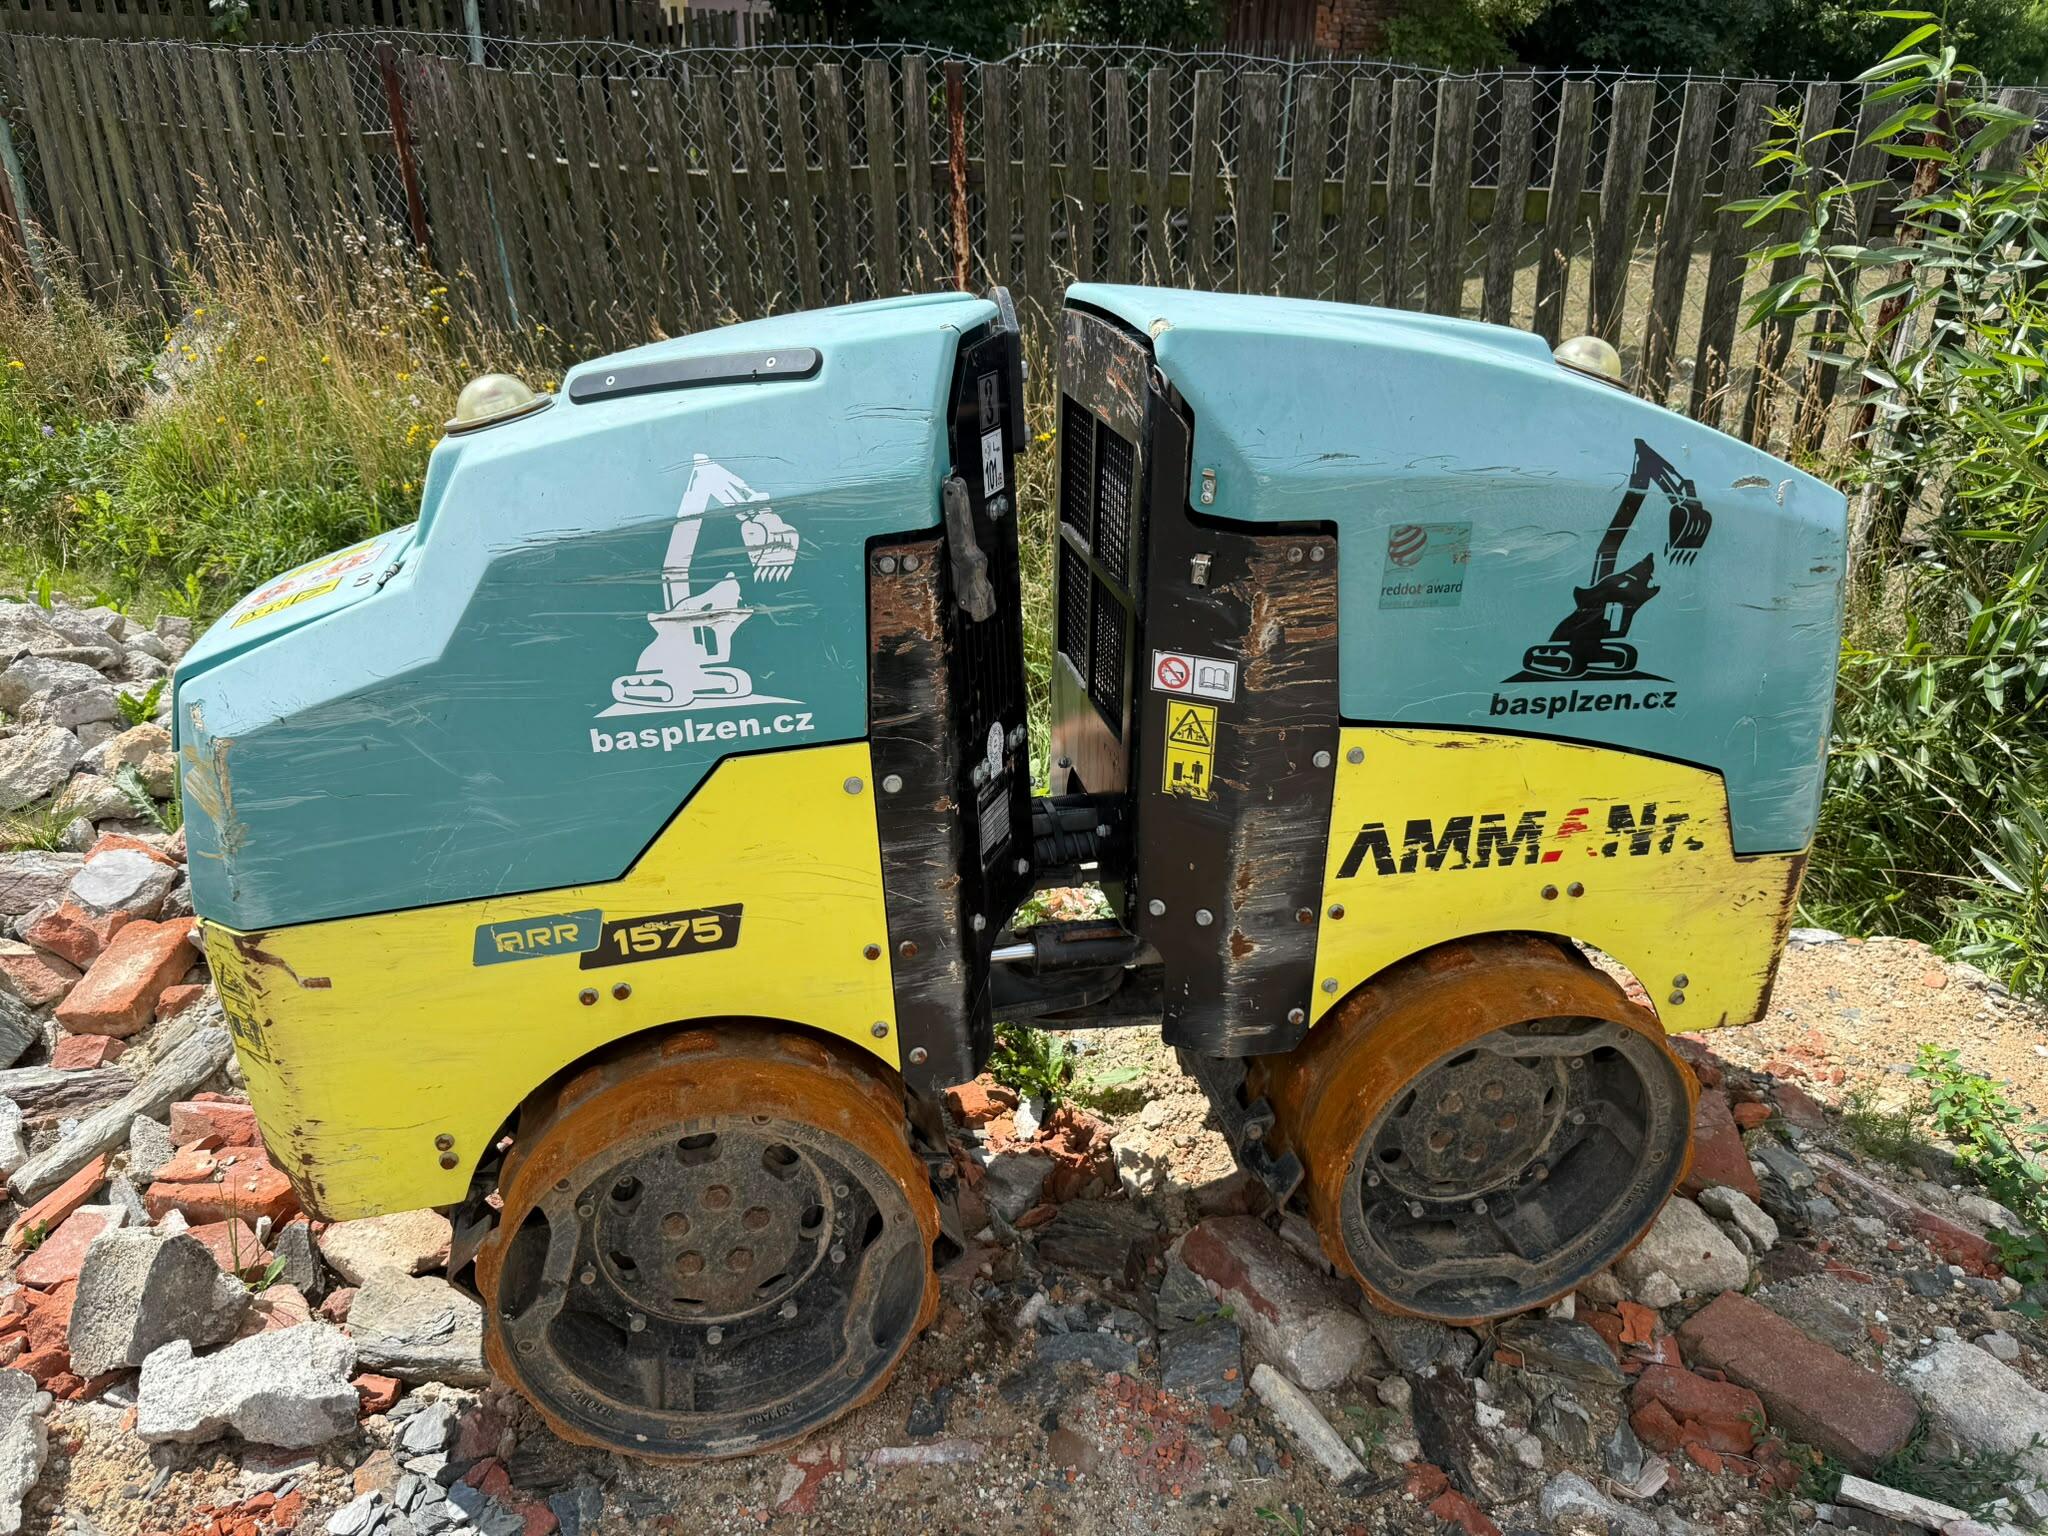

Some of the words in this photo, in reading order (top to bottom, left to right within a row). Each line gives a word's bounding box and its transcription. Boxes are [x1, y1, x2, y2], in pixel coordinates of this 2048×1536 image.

[1426, 580, 1463, 594] award
[1489, 690, 1678, 719] basplzen.cz
[590, 712, 815, 752] basplzen.cz
[495, 923, 579, 953] ARR
[612, 914, 723, 956] 1575
